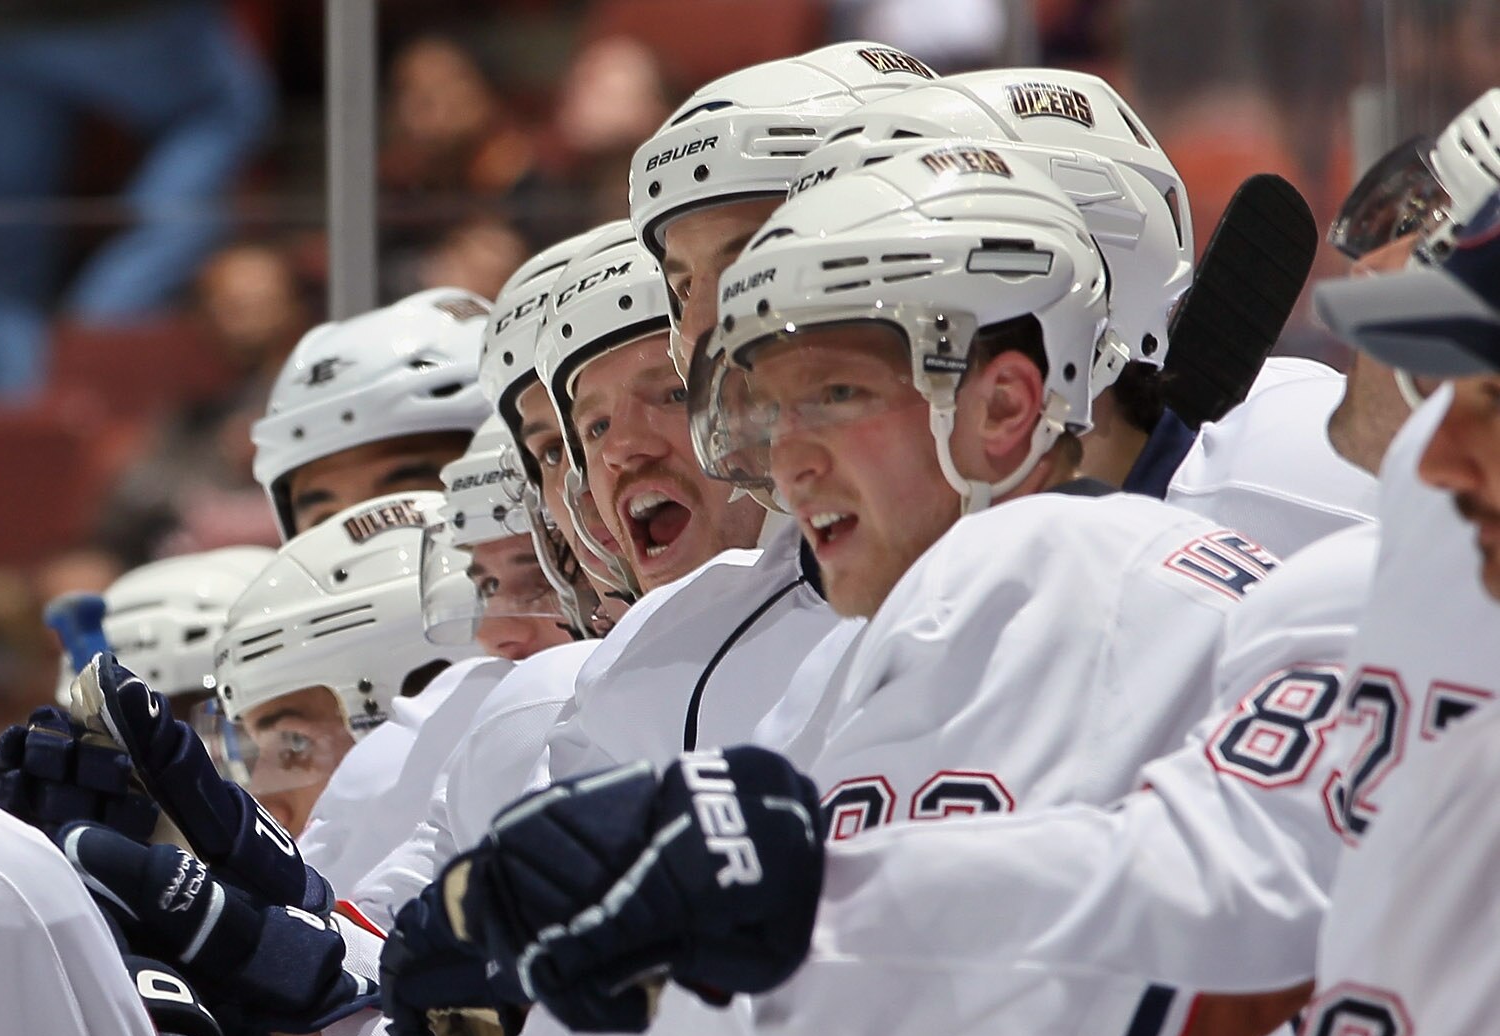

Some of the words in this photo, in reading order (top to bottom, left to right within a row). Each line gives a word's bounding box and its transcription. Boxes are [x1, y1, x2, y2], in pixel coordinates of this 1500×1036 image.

[1004, 84, 1096, 128] OILERS
[646, 136, 718, 172] BAUER
[557, 262, 633, 308] CCM
[722, 268, 776, 302] BAUER
[681, 748, 763, 888] UER
